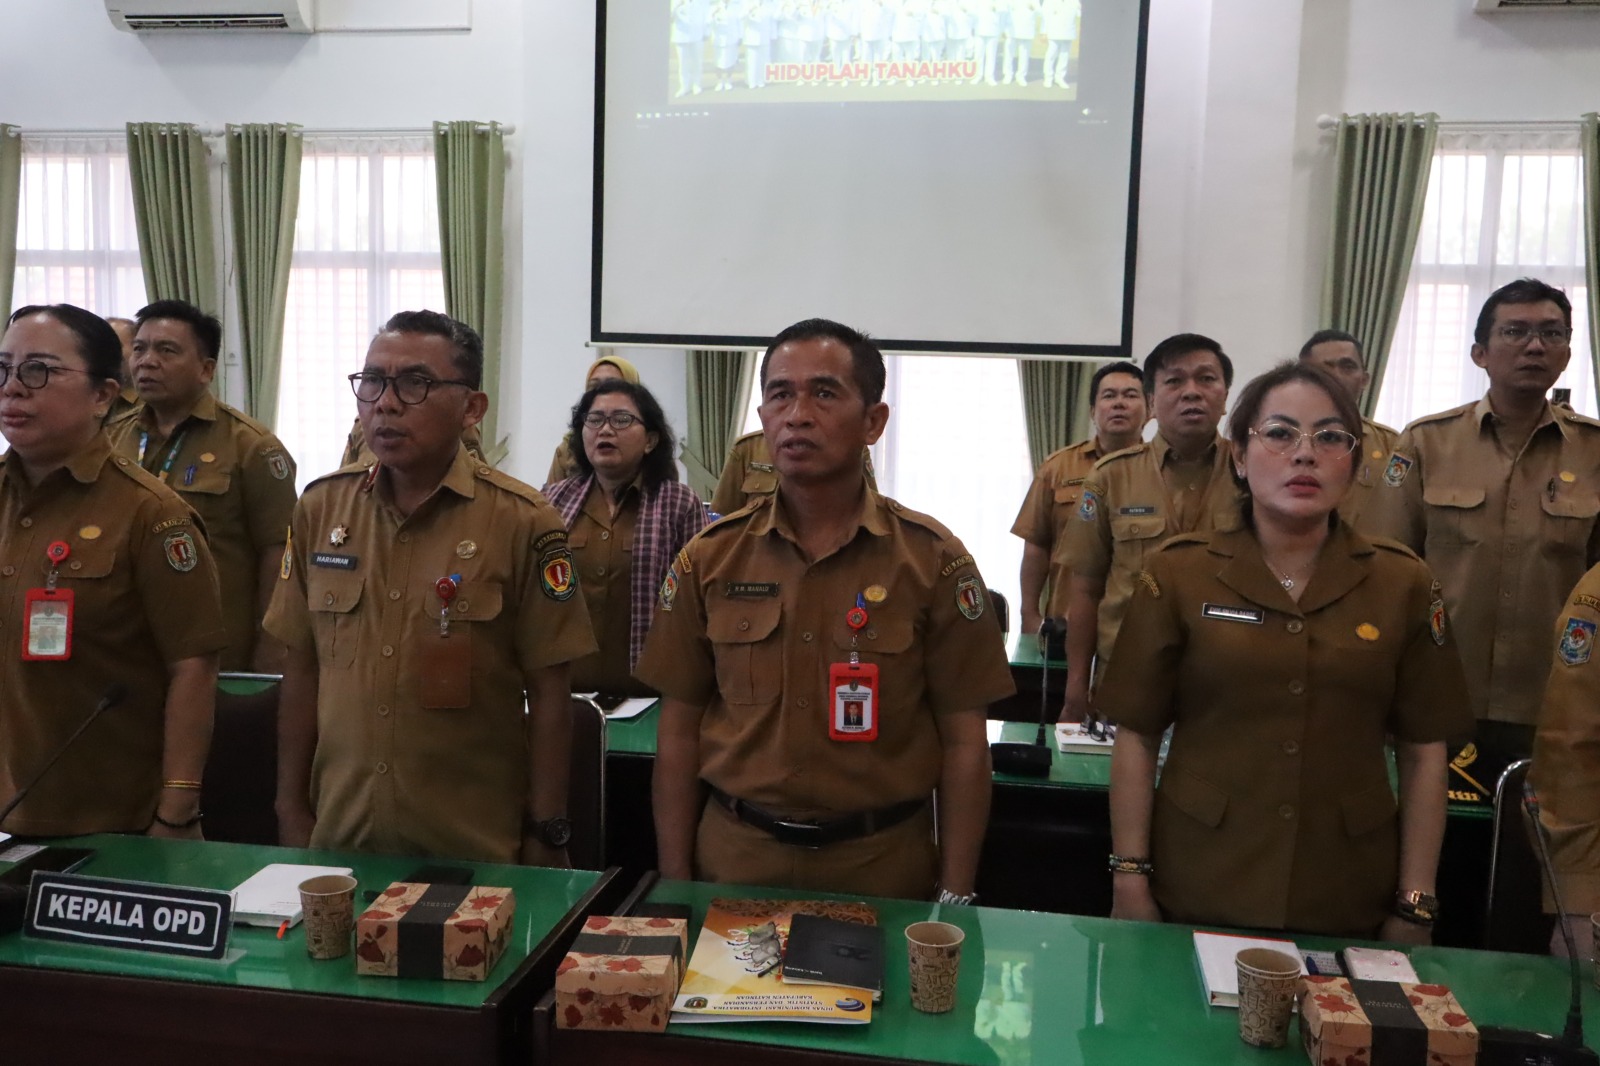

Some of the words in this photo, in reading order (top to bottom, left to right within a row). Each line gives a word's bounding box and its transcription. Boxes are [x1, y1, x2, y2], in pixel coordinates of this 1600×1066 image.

[765, 63, 869, 81] HIDUPLAH
[875, 61, 977, 79] TANAHKU
[316, 555, 349, 566] HARIAWAN
[48, 893, 144, 929] KEPALA
[153, 906, 206, 936] OPD
